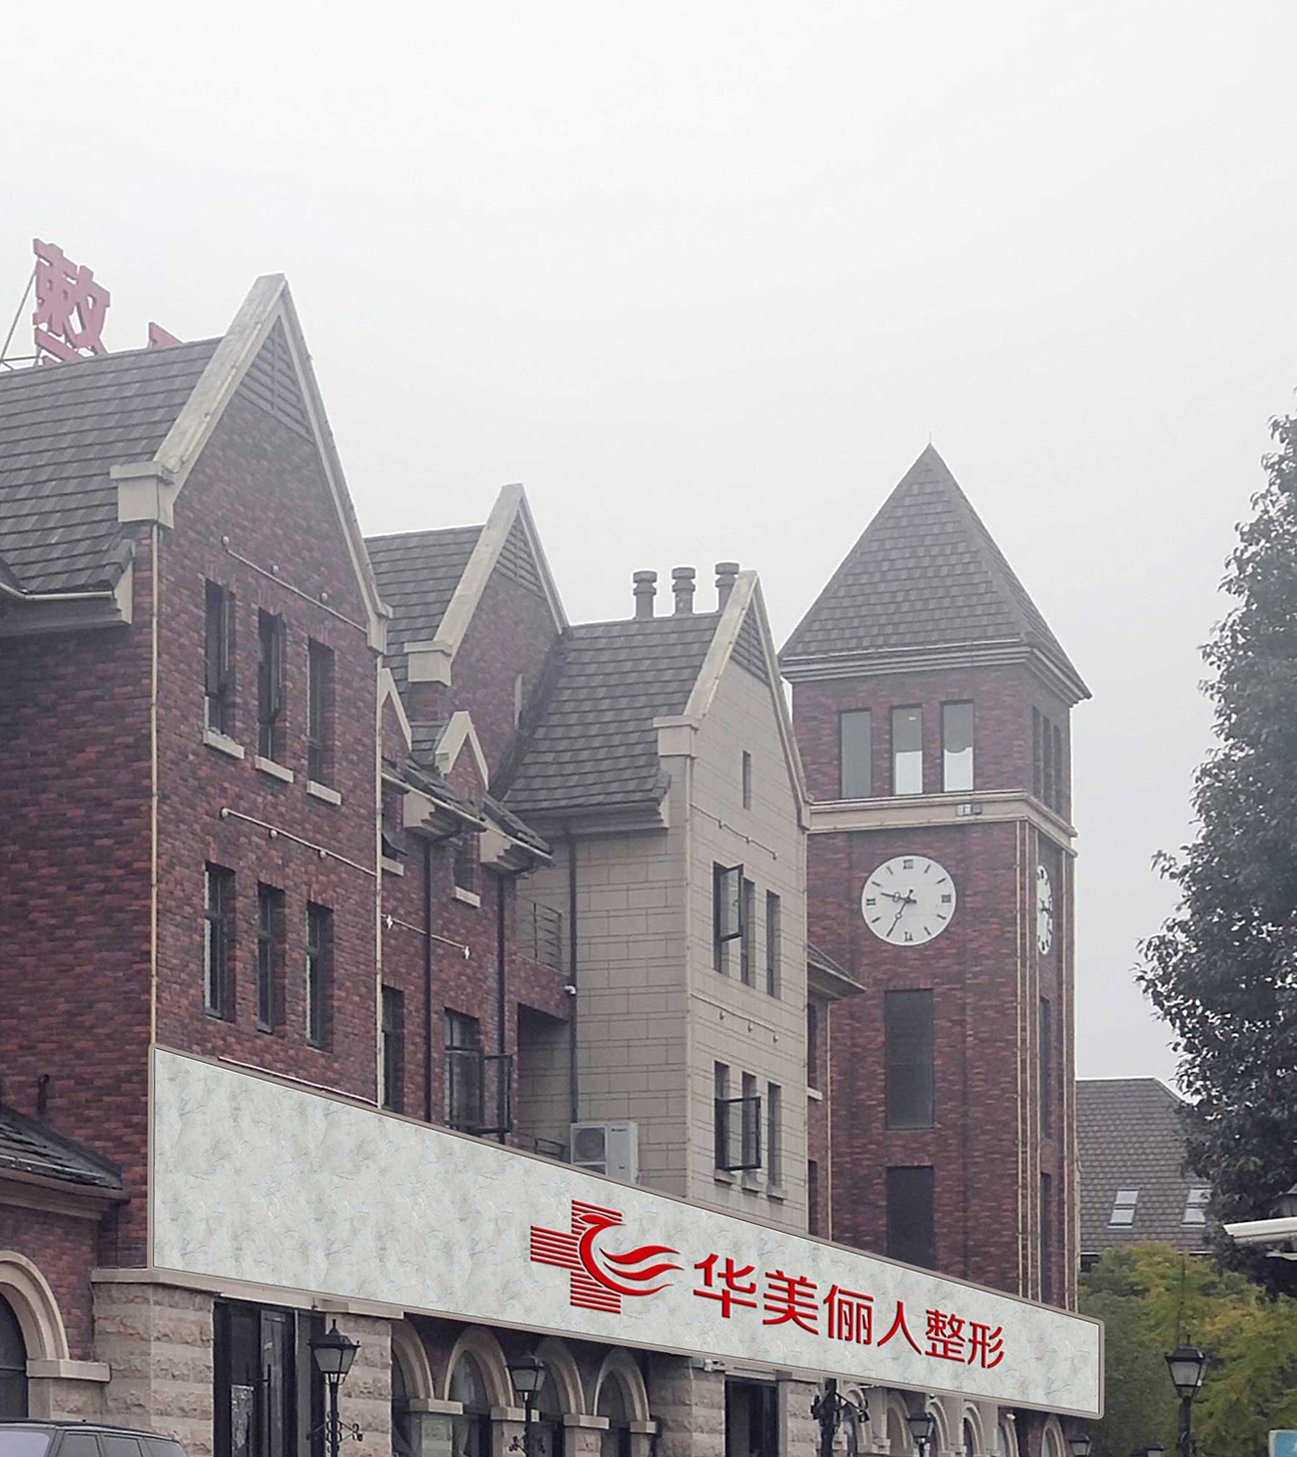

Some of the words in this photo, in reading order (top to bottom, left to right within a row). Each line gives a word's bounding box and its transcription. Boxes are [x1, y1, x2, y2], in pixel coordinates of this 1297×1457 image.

[693, 1252, 1006, 1369] 华美俪人整形
